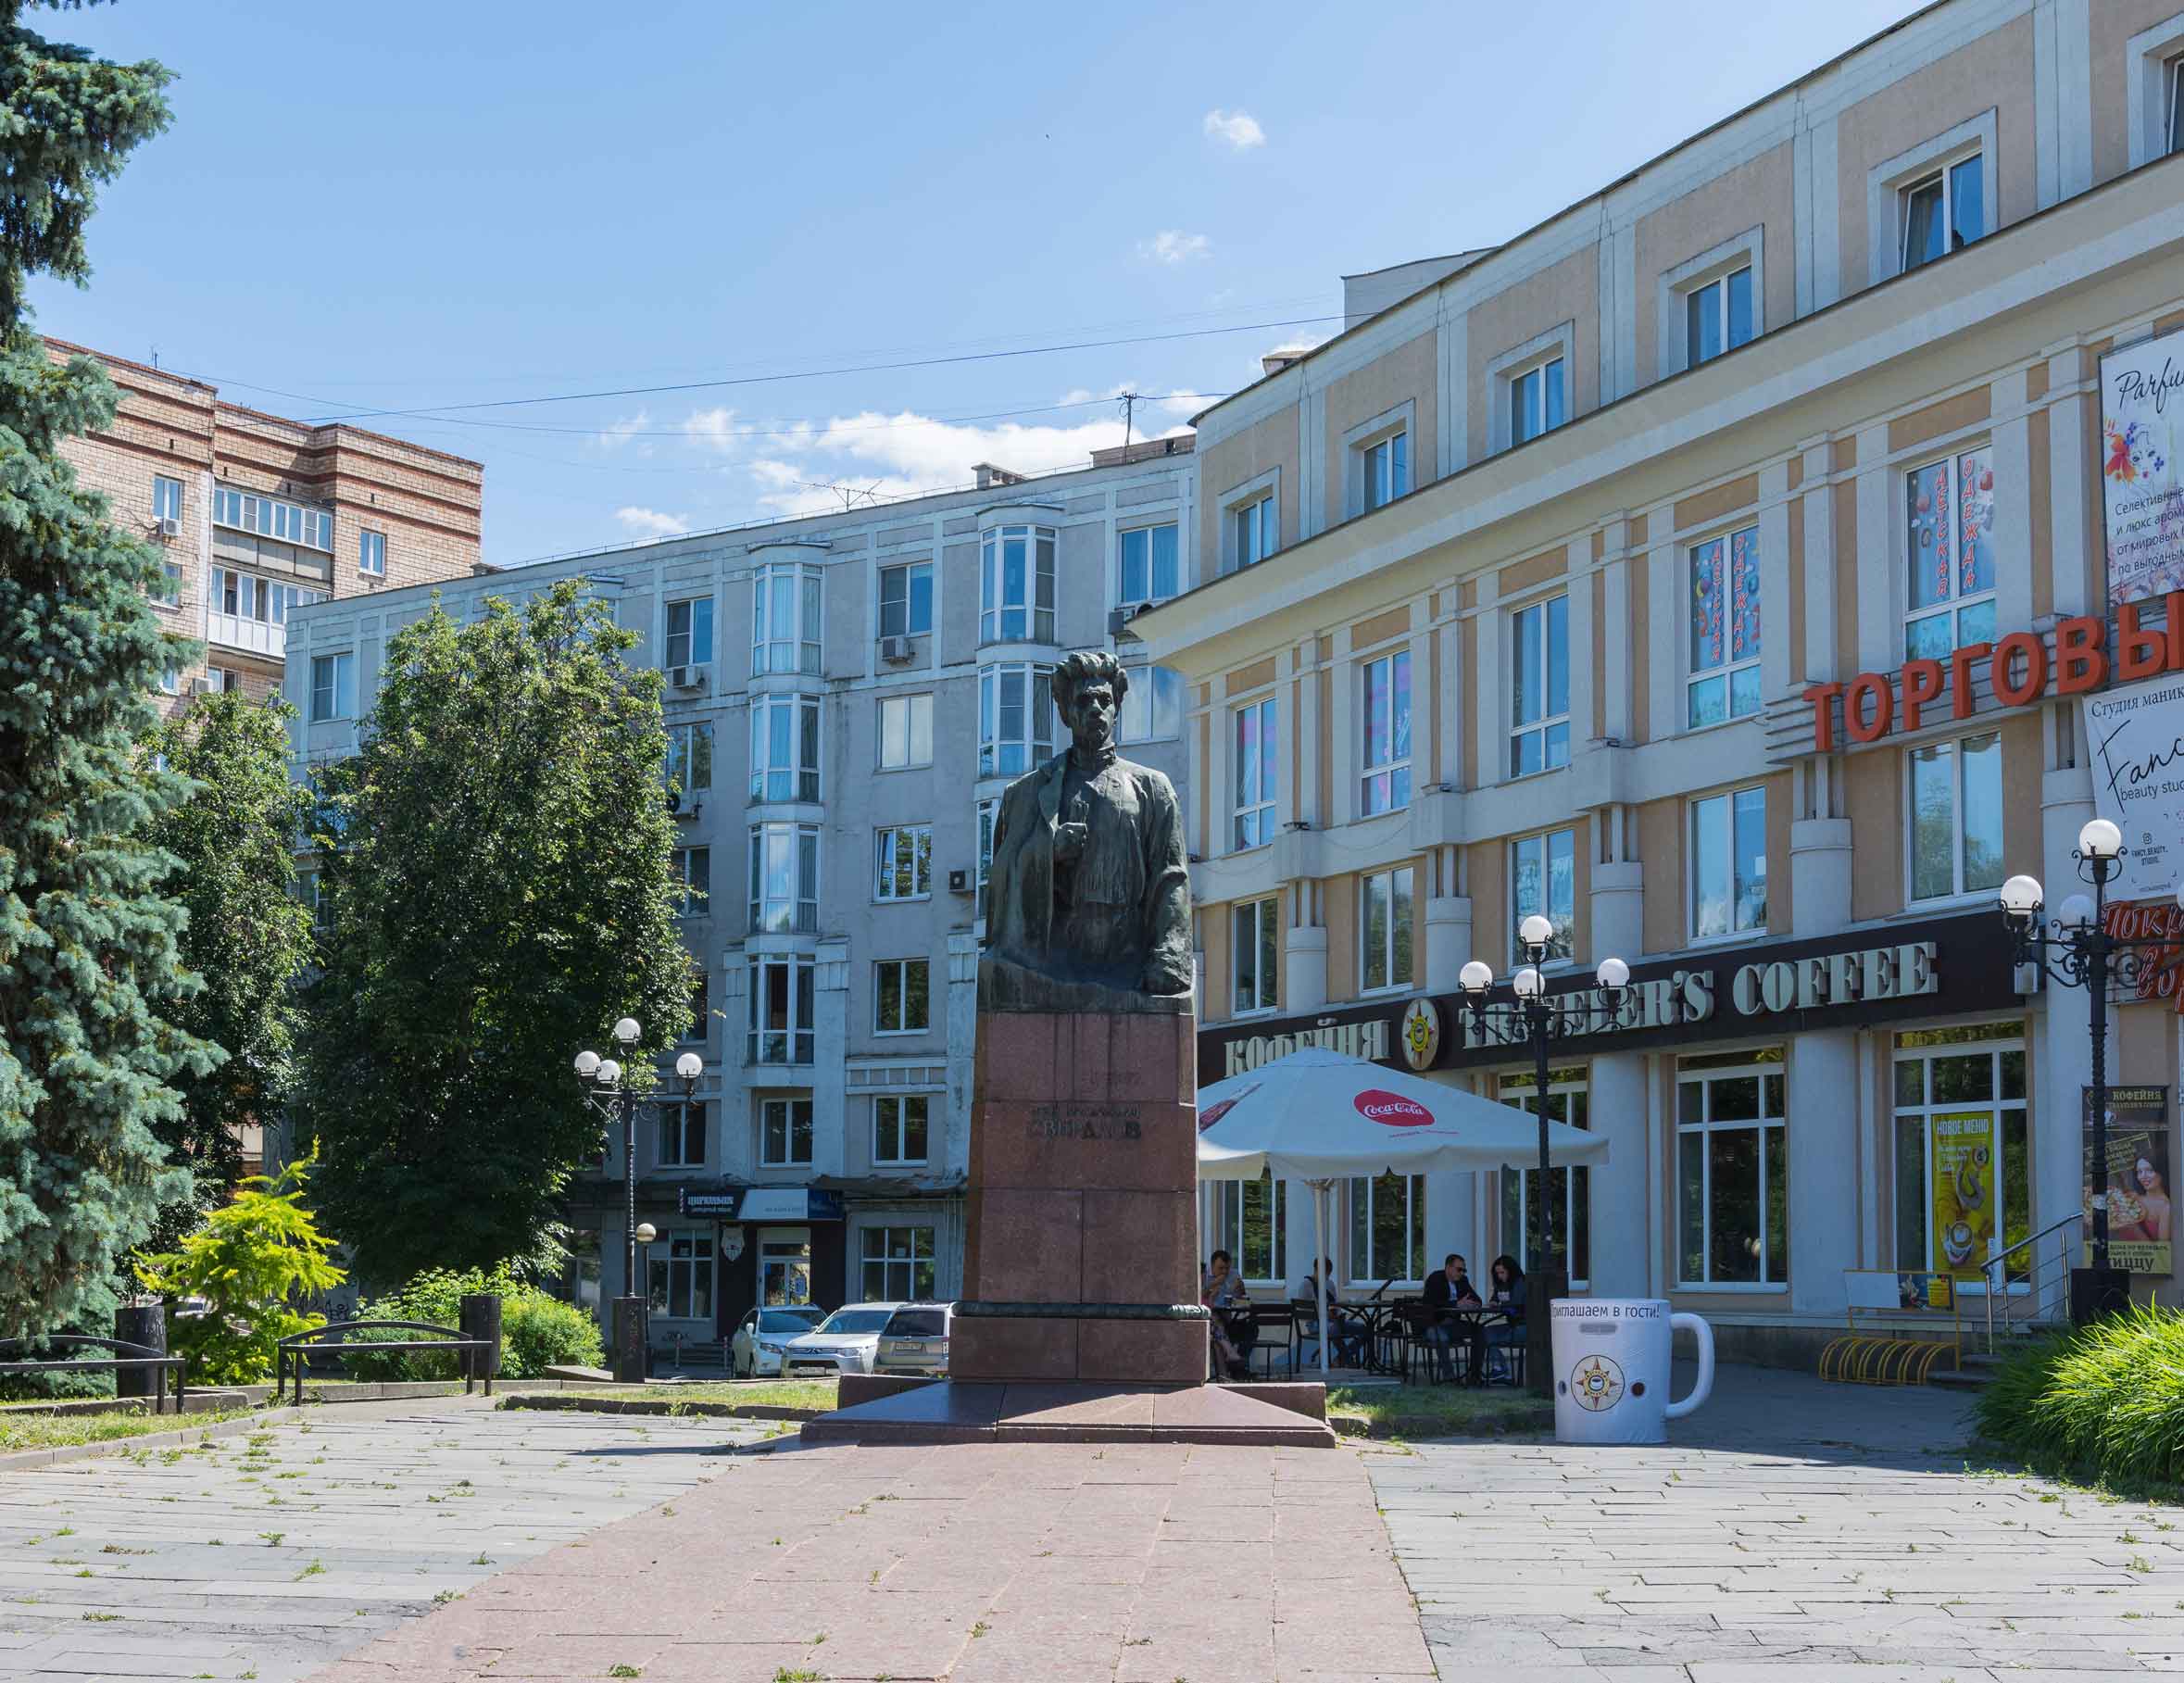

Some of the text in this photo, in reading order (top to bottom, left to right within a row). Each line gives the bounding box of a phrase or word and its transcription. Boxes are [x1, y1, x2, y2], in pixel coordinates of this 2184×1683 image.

[2115, 357, 2184, 414] Parfu
[2115, 487, 2184, 516] Селективные
[1935, 465, 1950, 597] ДЕТСКАЯ
[1962, 458, 1978, 588] ОДЕЖДА
[2116, 525, 2124, 535] и
[2126, 517, 2153, 534] люкс
[2117, 529, 2179, 556] от мировых
[2118, 564, 2131, 576] по
[1803, 592, 2184, 753] ТОРГОВЫ
[2090, 696, 2139, 720] Студия
[2120, 785, 2158, 801] beauty
[1732, 941, 1939, 1015] COFFEE
[2112, 1089, 2162, 1100] КОФЕЙНЯ
[1363, 1102, 1424, 1117] Coca-Cola
[1937, 1118, 1989, 1135] НОВОЕ МЕНЮ
[2107, 1257, 2155, 1273] иццу
[1613, 1306, 1620, 1317] в
[1625, 1303, 1660, 1319] гости!
